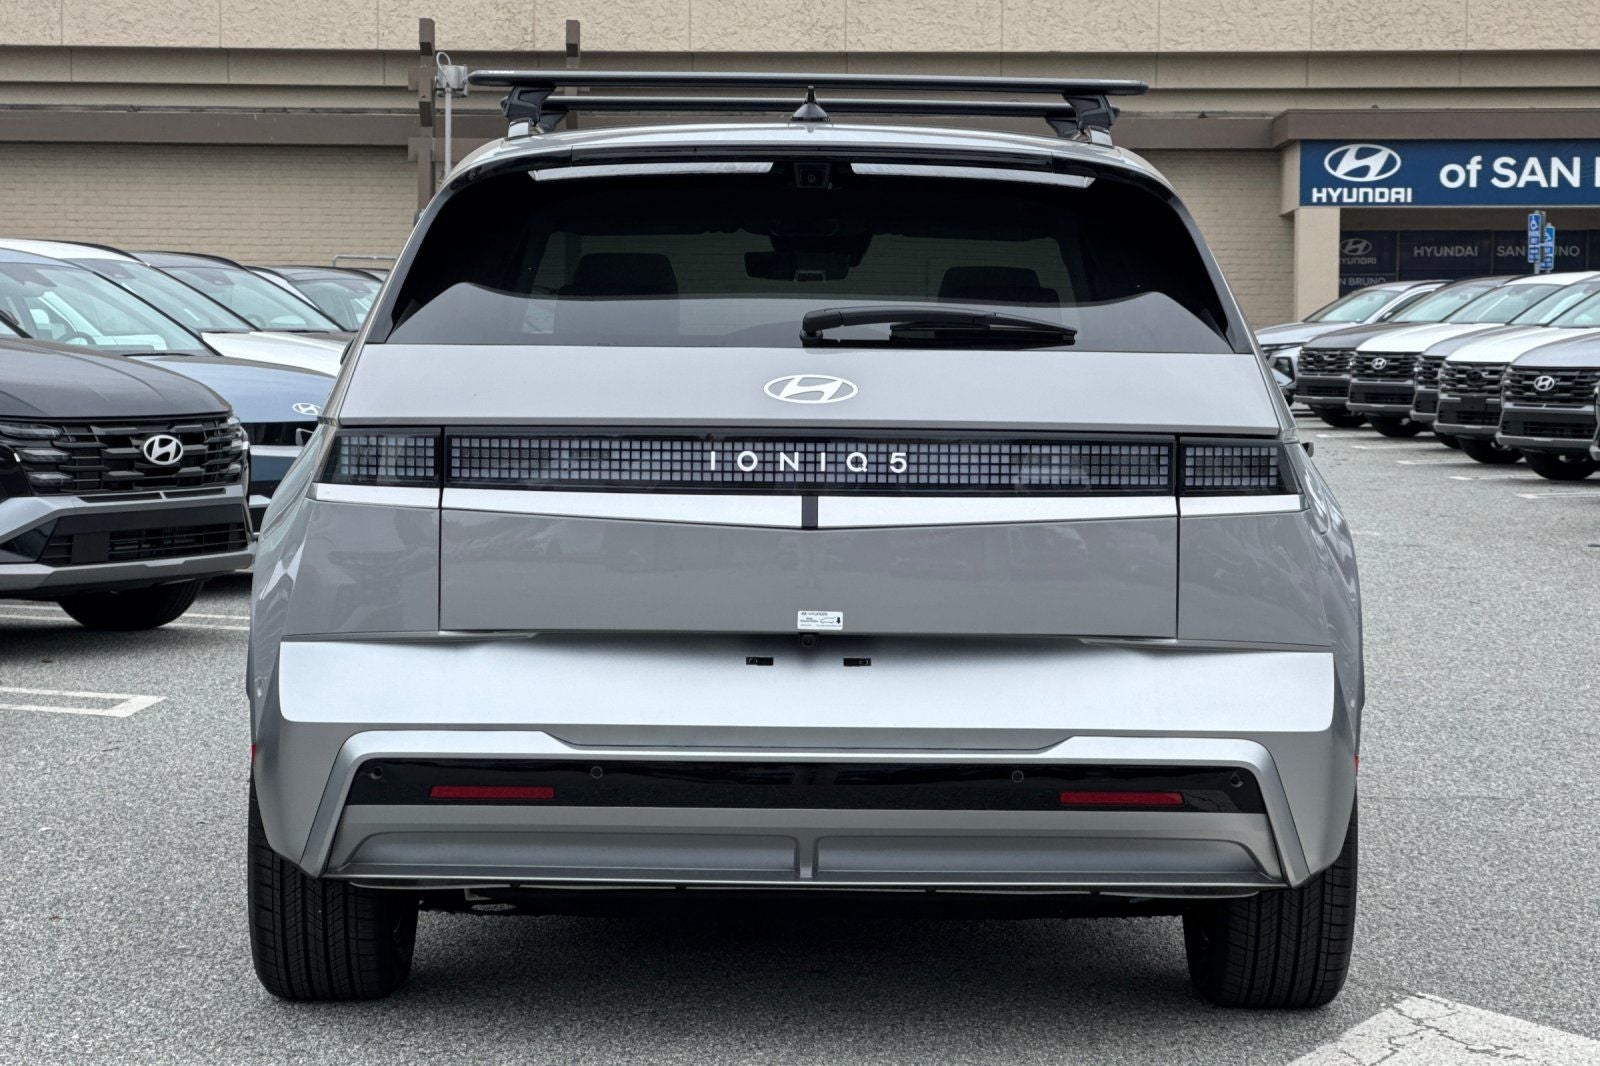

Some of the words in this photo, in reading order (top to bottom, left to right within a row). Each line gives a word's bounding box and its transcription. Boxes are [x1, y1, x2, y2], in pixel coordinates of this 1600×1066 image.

[1439, 155, 1482, 189] of
[1490, 156, 1581, 189] SAN
[1311, 187, 1413, 203] HYUNDAI
[1414, 245, 1478, 257] HYUNDAI
[1497, 245, 1526, 257] SAN
